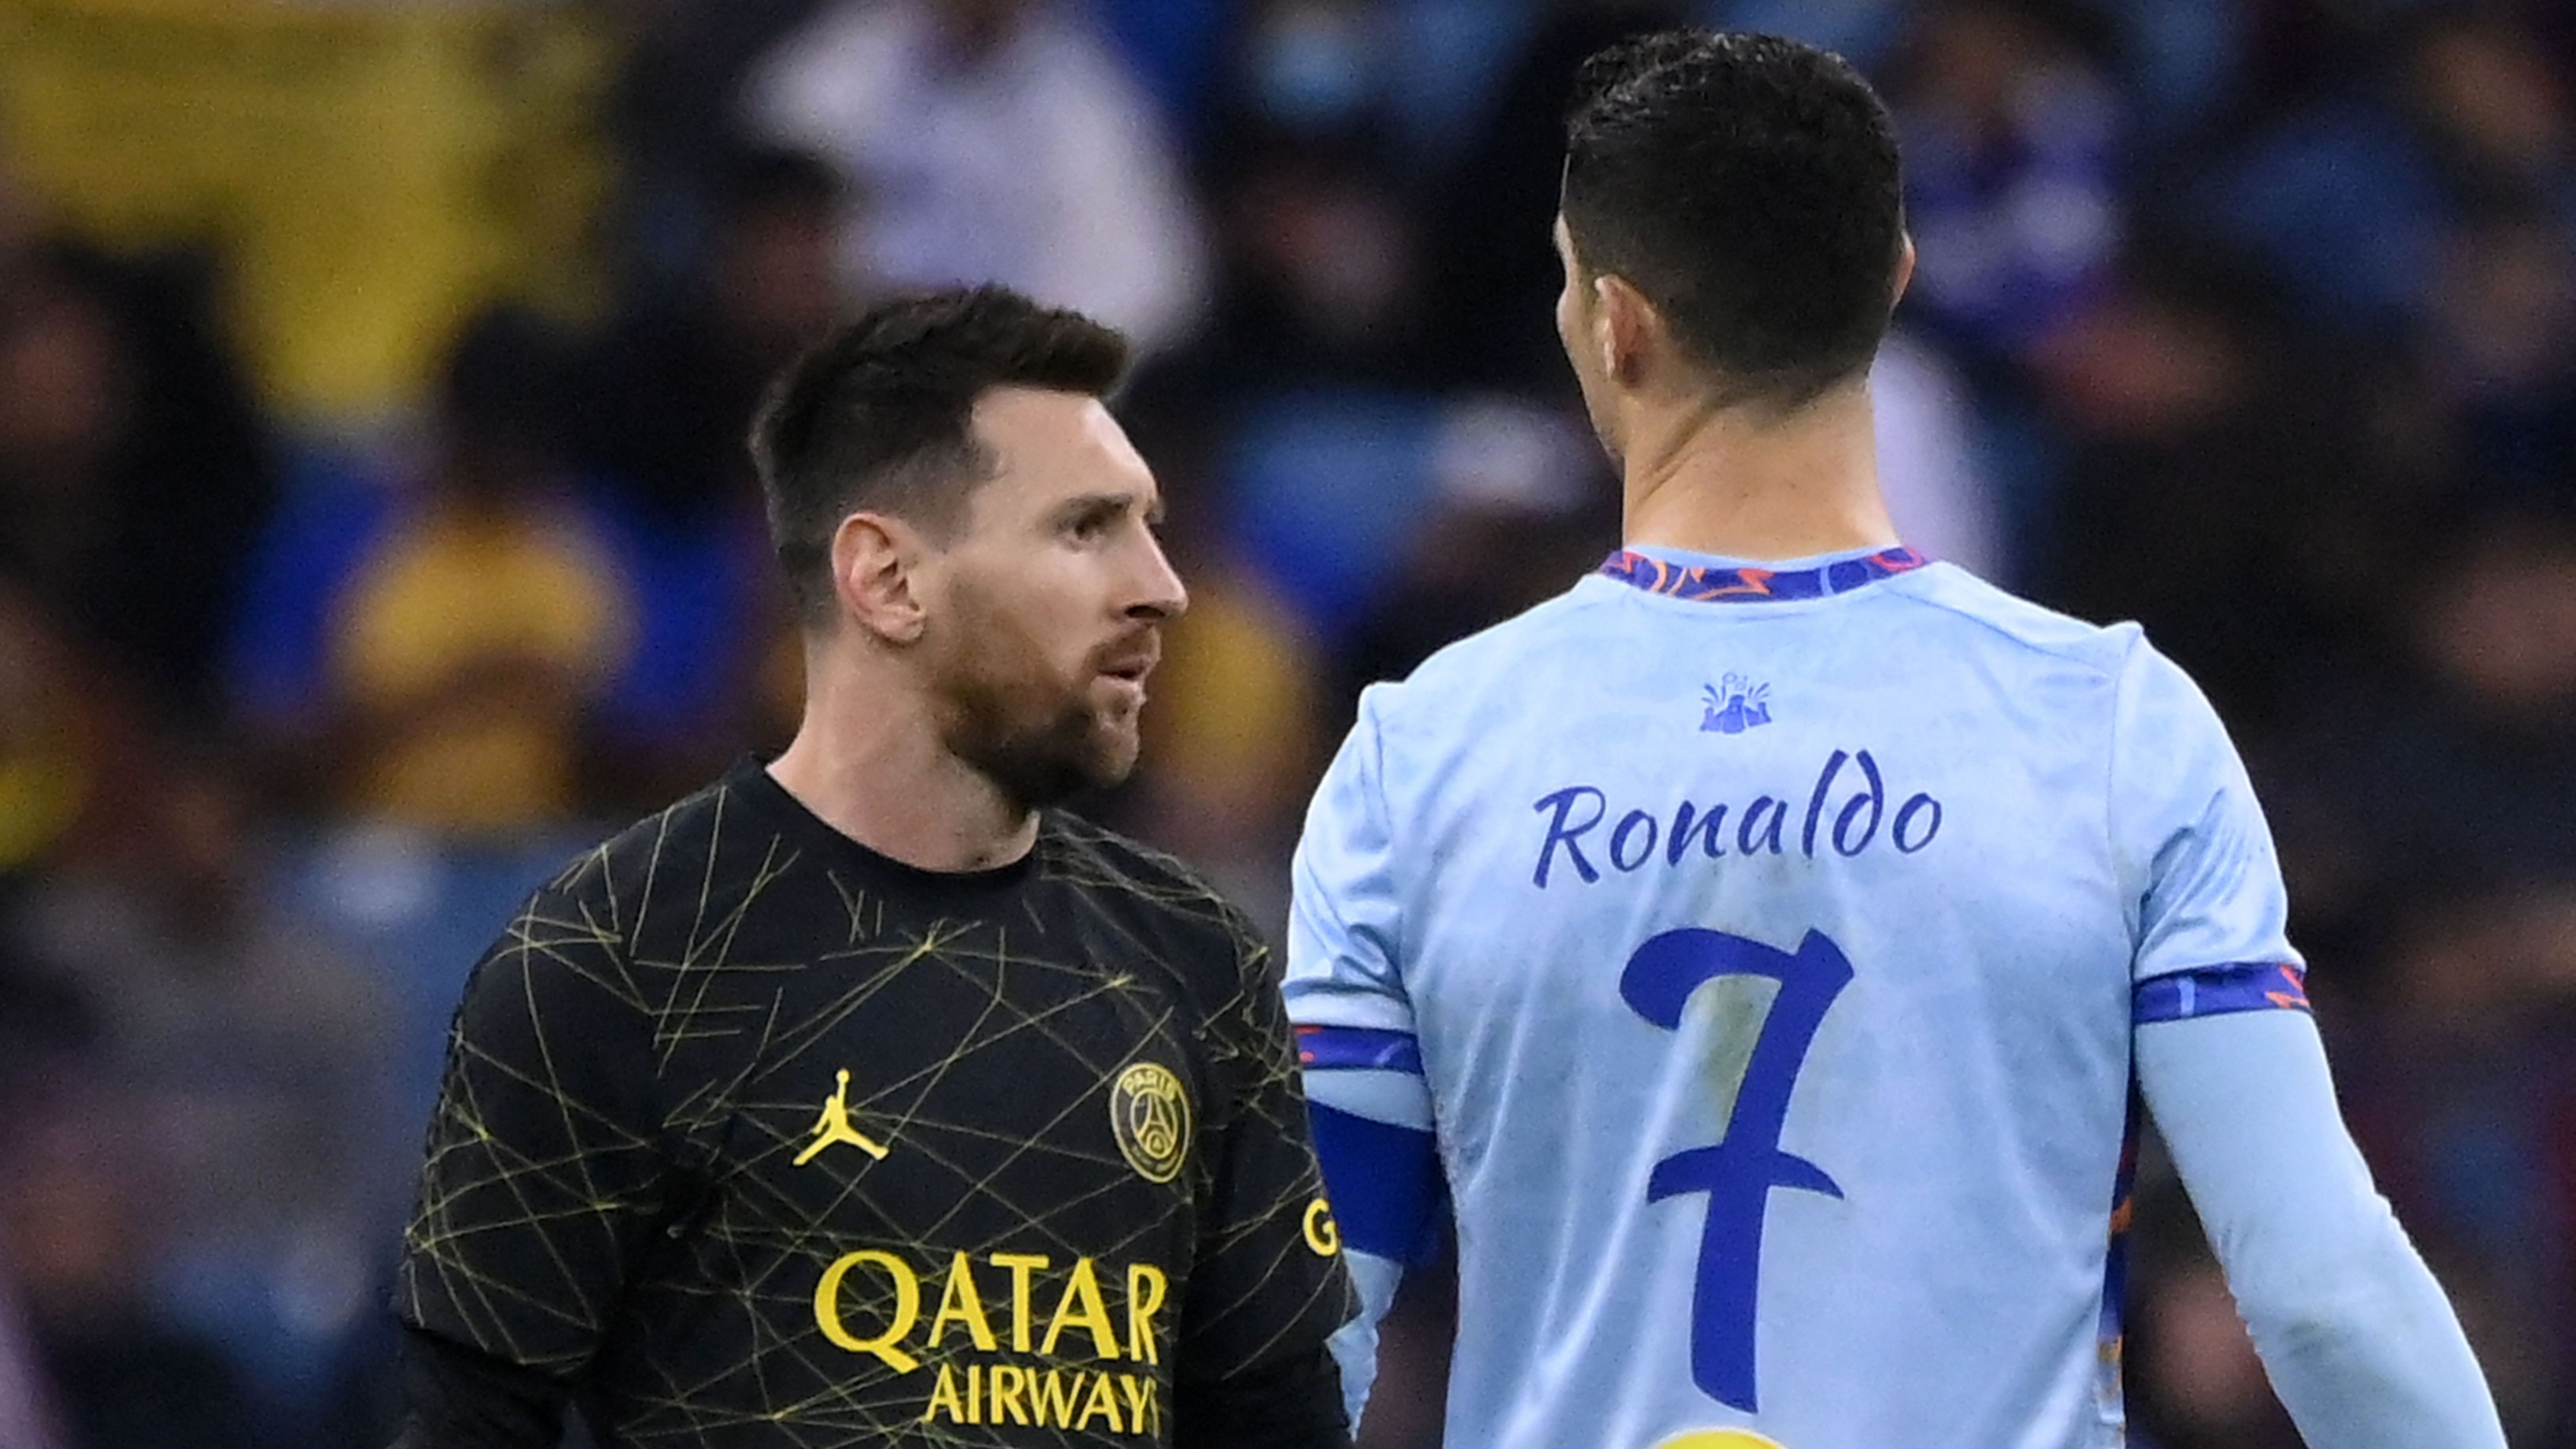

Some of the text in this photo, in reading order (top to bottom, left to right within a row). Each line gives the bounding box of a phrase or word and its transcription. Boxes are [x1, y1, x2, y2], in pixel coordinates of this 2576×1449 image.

[1532, 749, 1942, 889] Ronaldo
[1122, 1070, 1178, 1101] PARIS
[1620, 927, 1855, 1413] 7
[814, 1249, 1168, 1373] QATAR
